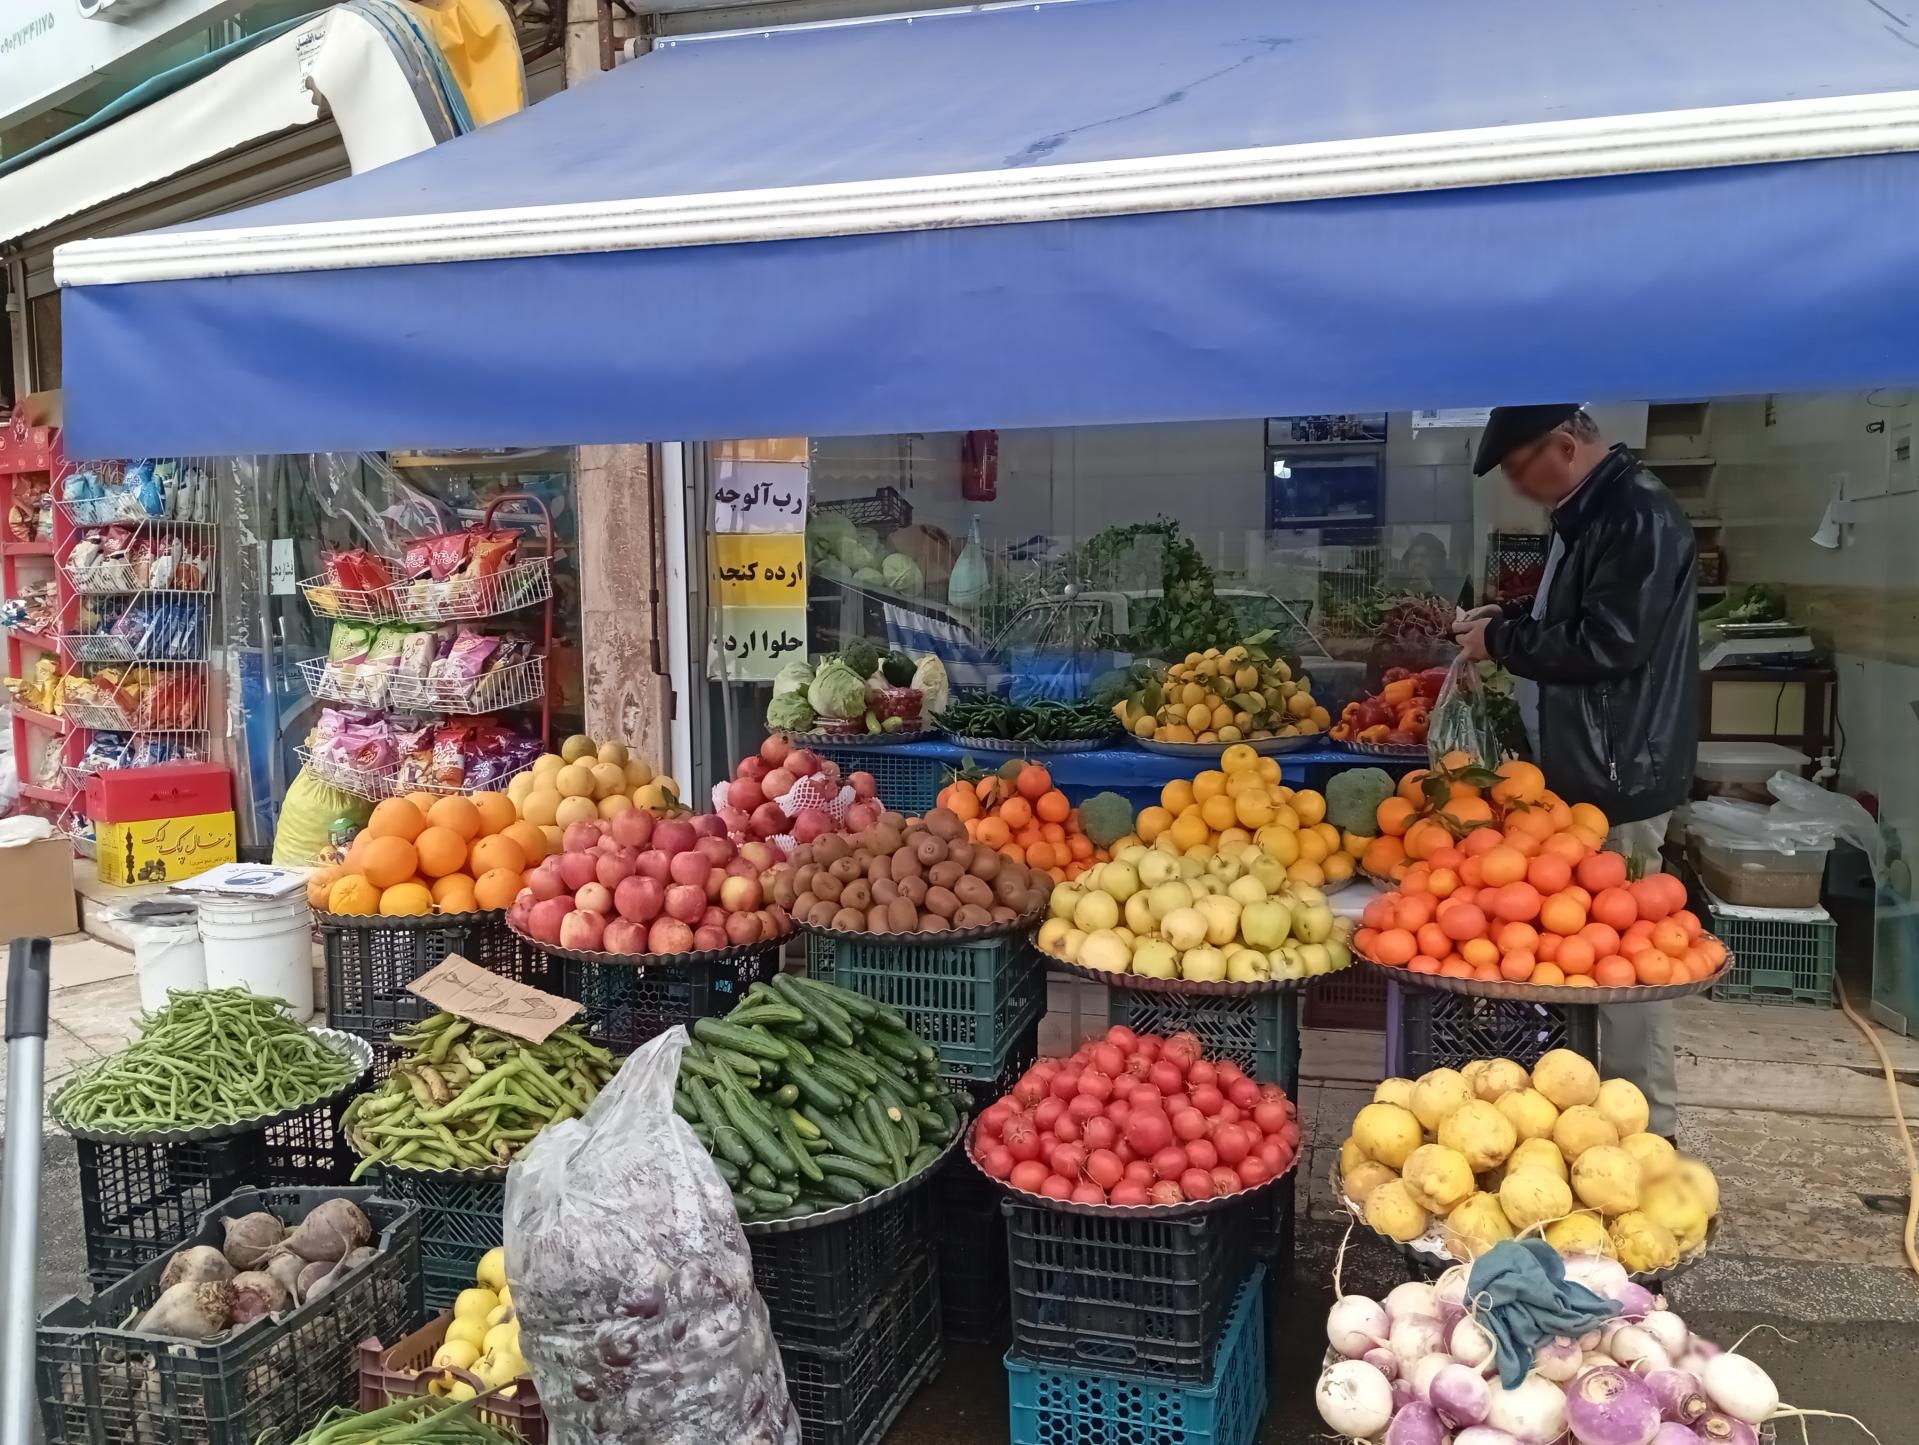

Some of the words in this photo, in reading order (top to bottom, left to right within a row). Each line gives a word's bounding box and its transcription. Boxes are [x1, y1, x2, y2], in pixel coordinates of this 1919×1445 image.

[714, 481, 774, 512] آلوچه
[772, 492, 803, 515] رب
[763, 561, 803, 588] ارده
[762, 629, 804, 659] حلوا
